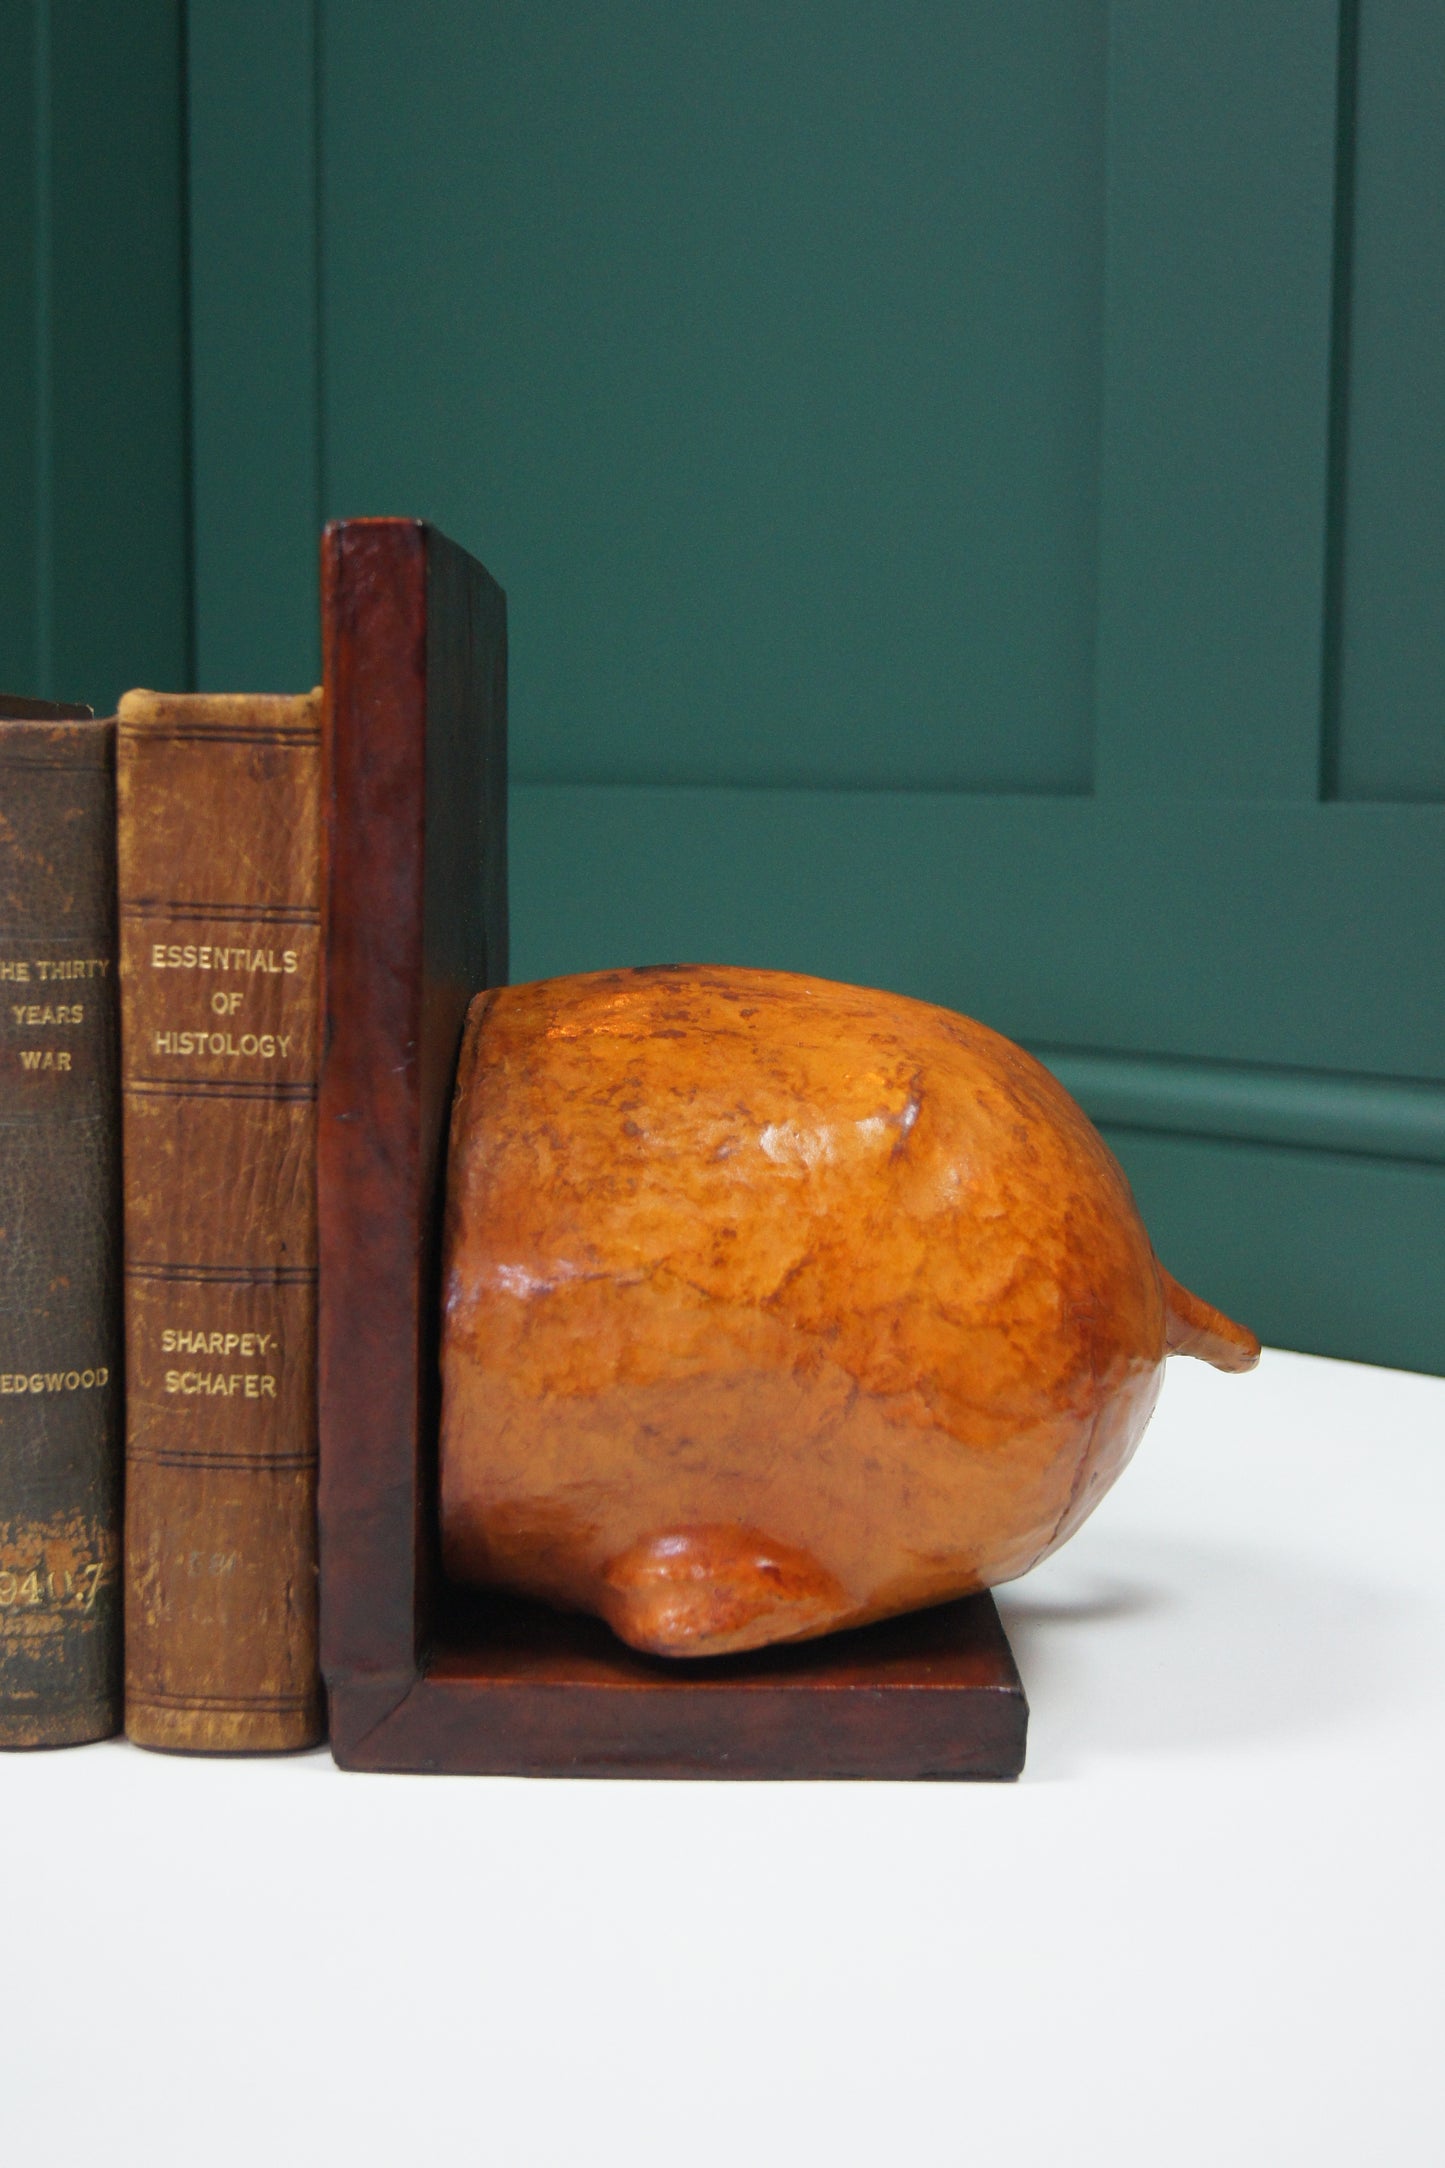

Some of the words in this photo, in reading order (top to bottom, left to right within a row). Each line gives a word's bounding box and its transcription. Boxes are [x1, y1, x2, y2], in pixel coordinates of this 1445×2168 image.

[35, 959, 110, 981] THIRTY
[152, 944, 298, 974] ESSENTIALS
[12, 1004, 84, 1025] YEARS
[211, 992, 244, 1015] OF
[155, 1031, 291, 1058] HISTOLOGY
[19, 1050, 72, 1071] WAR
[162, 1329, 278, 1356] SHARPEY-
[0, 1367, 109, 1394] EDGWOOD
[165, 1369, 277, 1398] SCHAFER
